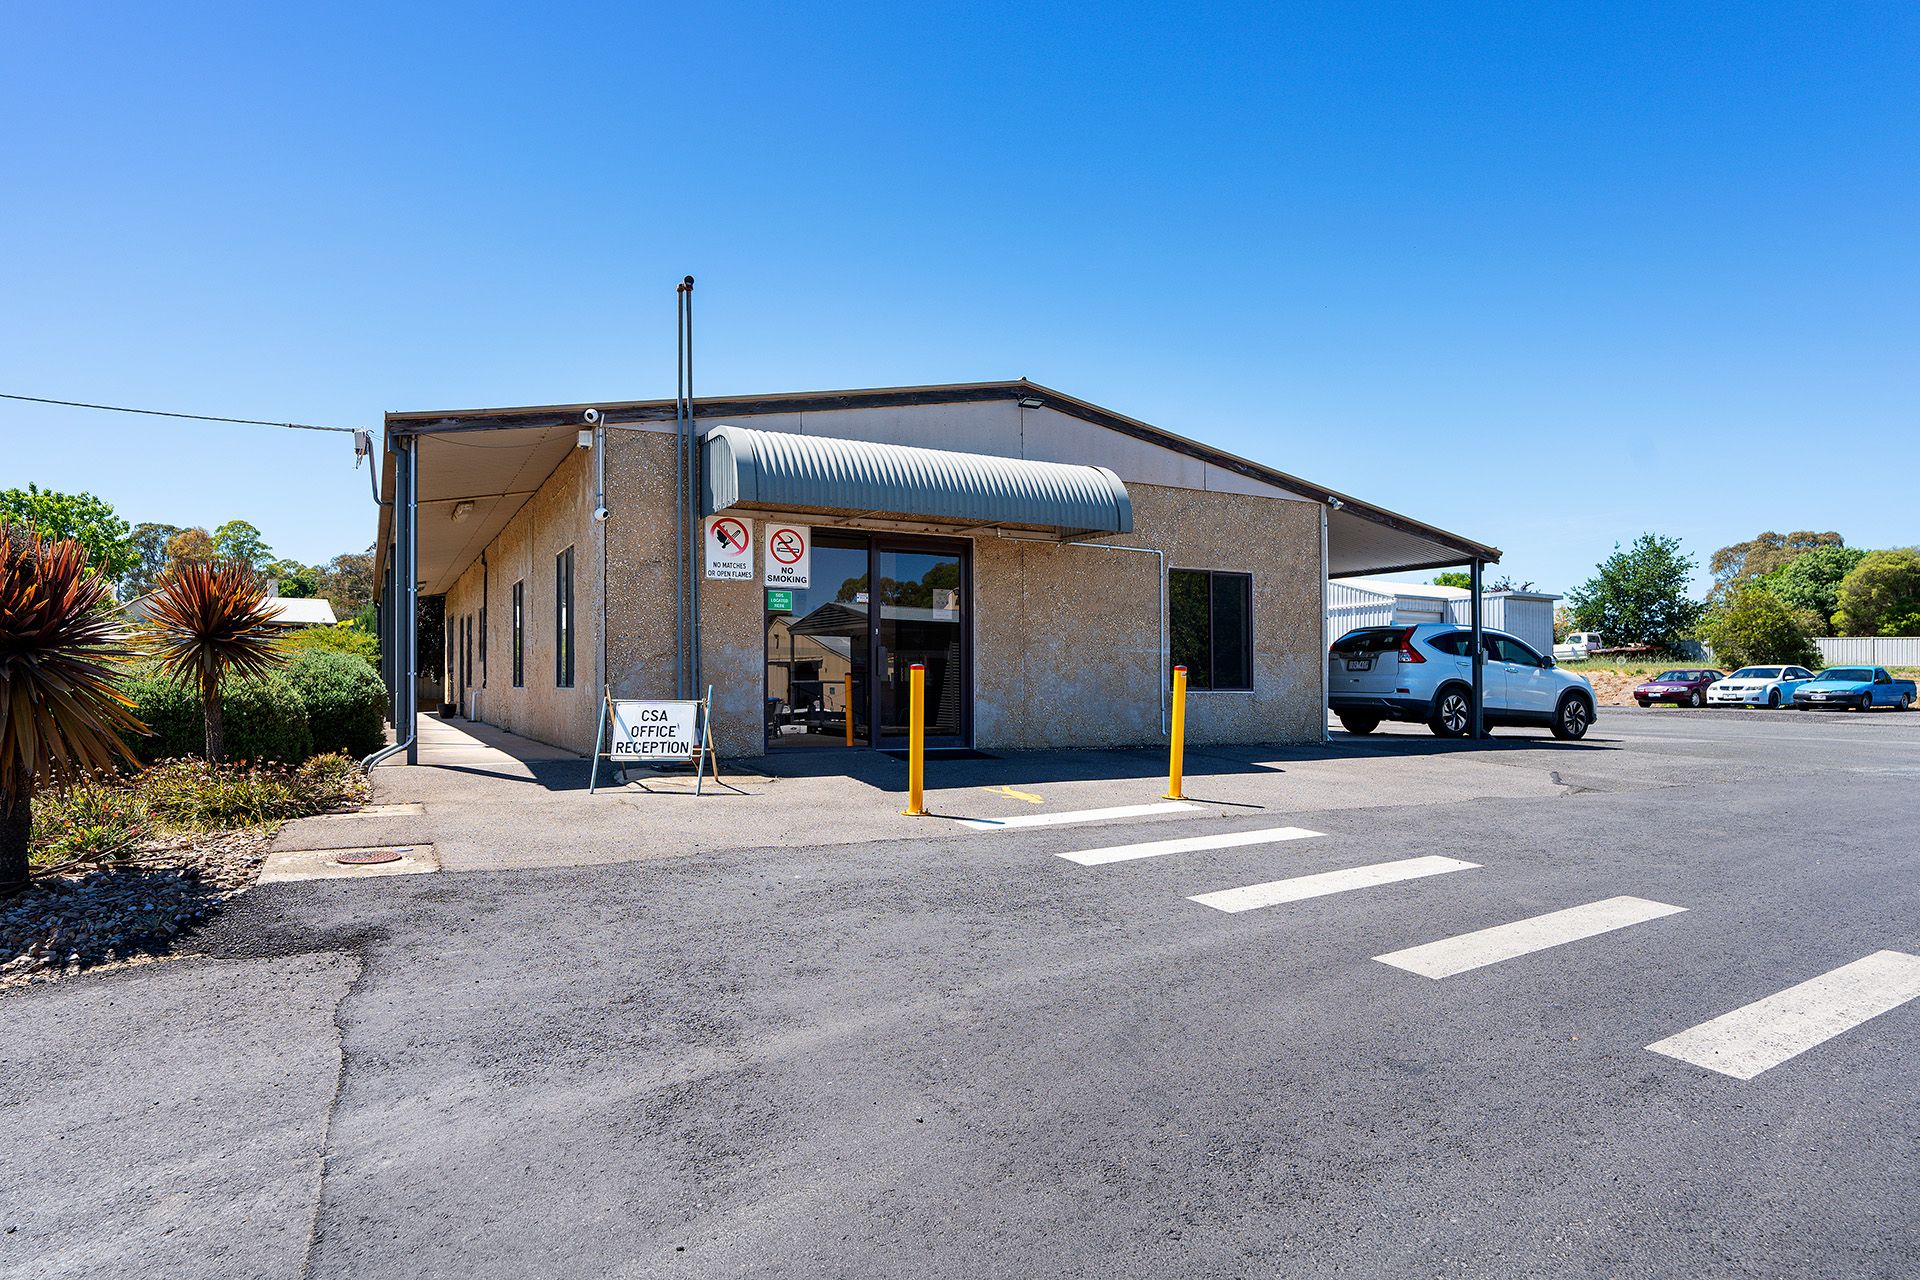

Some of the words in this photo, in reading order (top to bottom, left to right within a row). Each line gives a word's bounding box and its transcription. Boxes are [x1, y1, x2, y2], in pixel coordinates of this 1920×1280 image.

[722, 562, 746, 570] MATCHES
[781, 567, 794, 575] NO
[767, 575, 807, 583] SMOKING
[642, 710, 668, 721] CSA
[631, 726, 676, 737] OFFICE
[616, 742, 688, 753] RECEPTION
